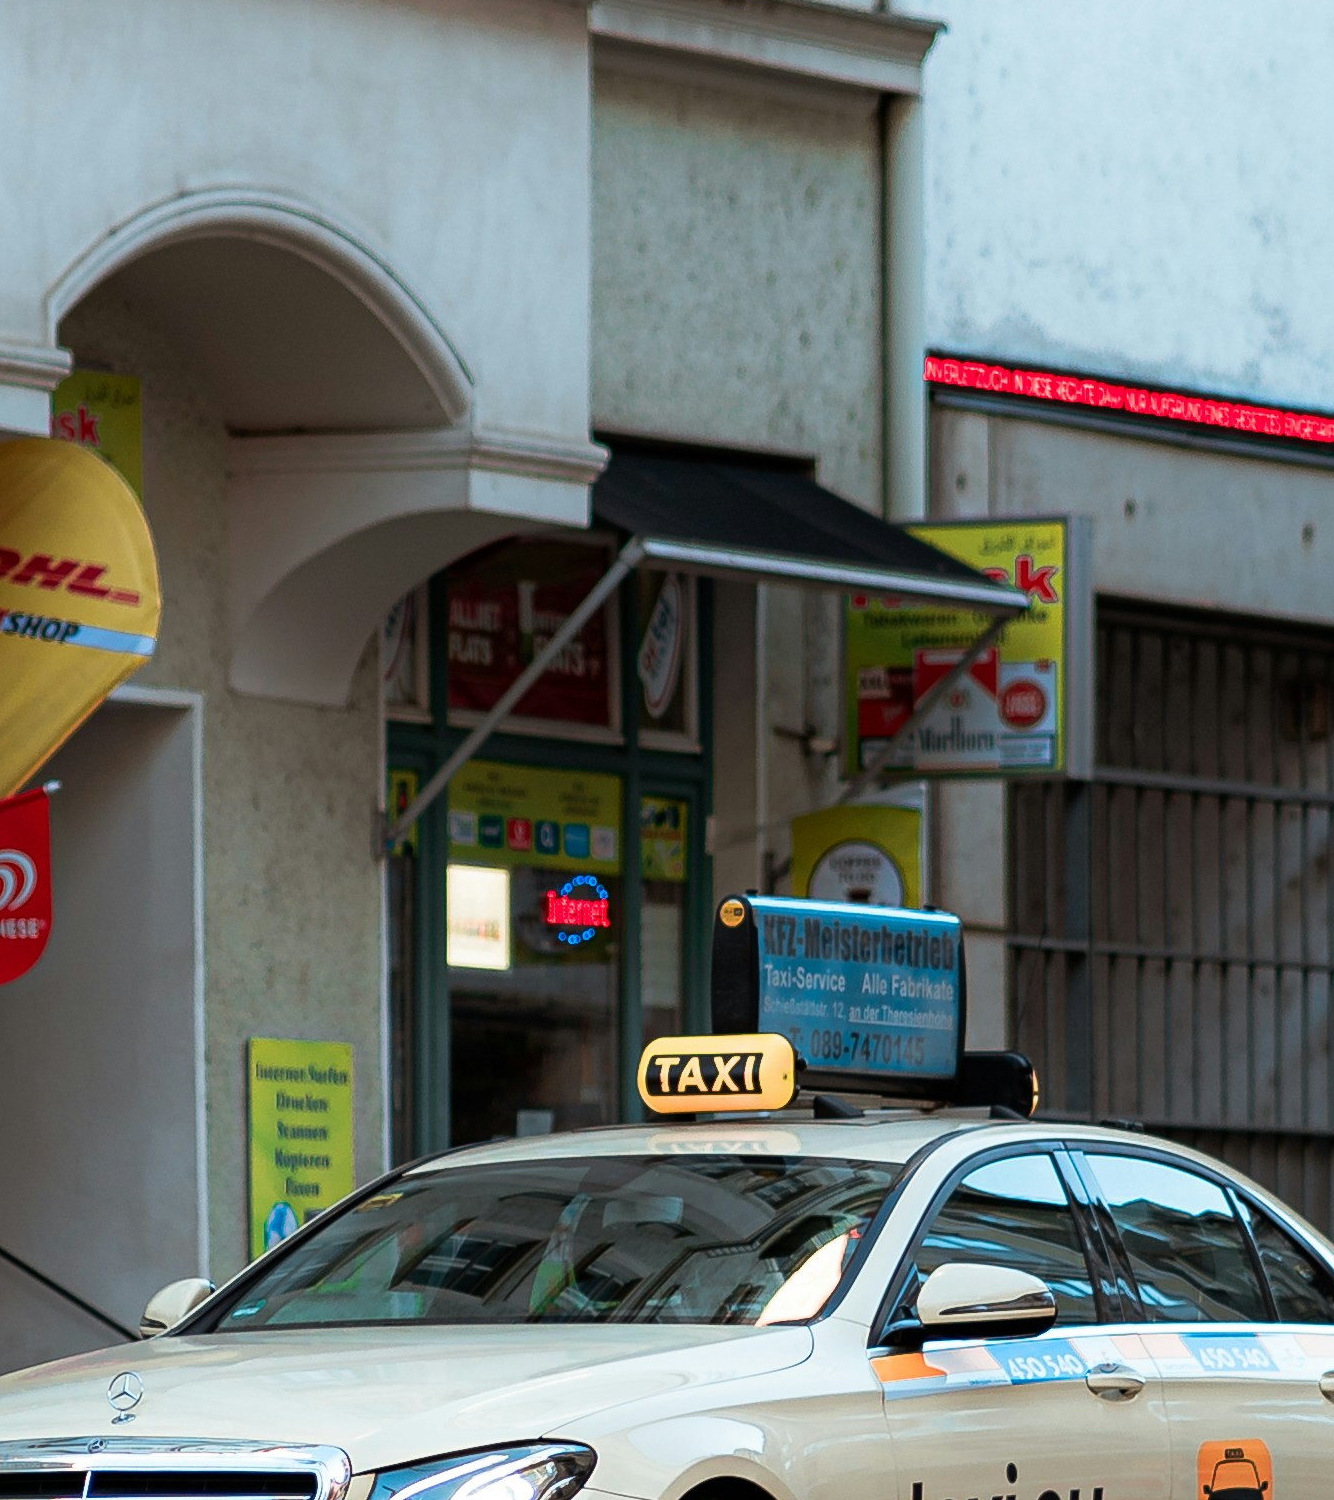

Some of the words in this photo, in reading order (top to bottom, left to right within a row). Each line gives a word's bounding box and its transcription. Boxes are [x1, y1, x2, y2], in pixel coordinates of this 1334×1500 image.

[53, 404, 100, 446] sk
[762, 914, 955, 971] KFZ-Meisterbetrieb
[764, 963, 846, 993] Taxi-Service
[861, 972, 887, 996] Alle
[890, 974, 954, 1001] Fabrikate
[848, 1006, 862, 1023] an
[862, 1004, 880, 1023] der
[810, 1029, 926, 1066] 089-7470145
[654, 1055, 757, 1093] TAXI
[277, 1121, 327, 1141] Scannen
[1008, 1356, 1047, 1380] 450
[1042, 1354, 1084, 1377] 540
[1199, 1347, 1236, 1370] 450
[1232, 1347, 1270, 1369] 540
